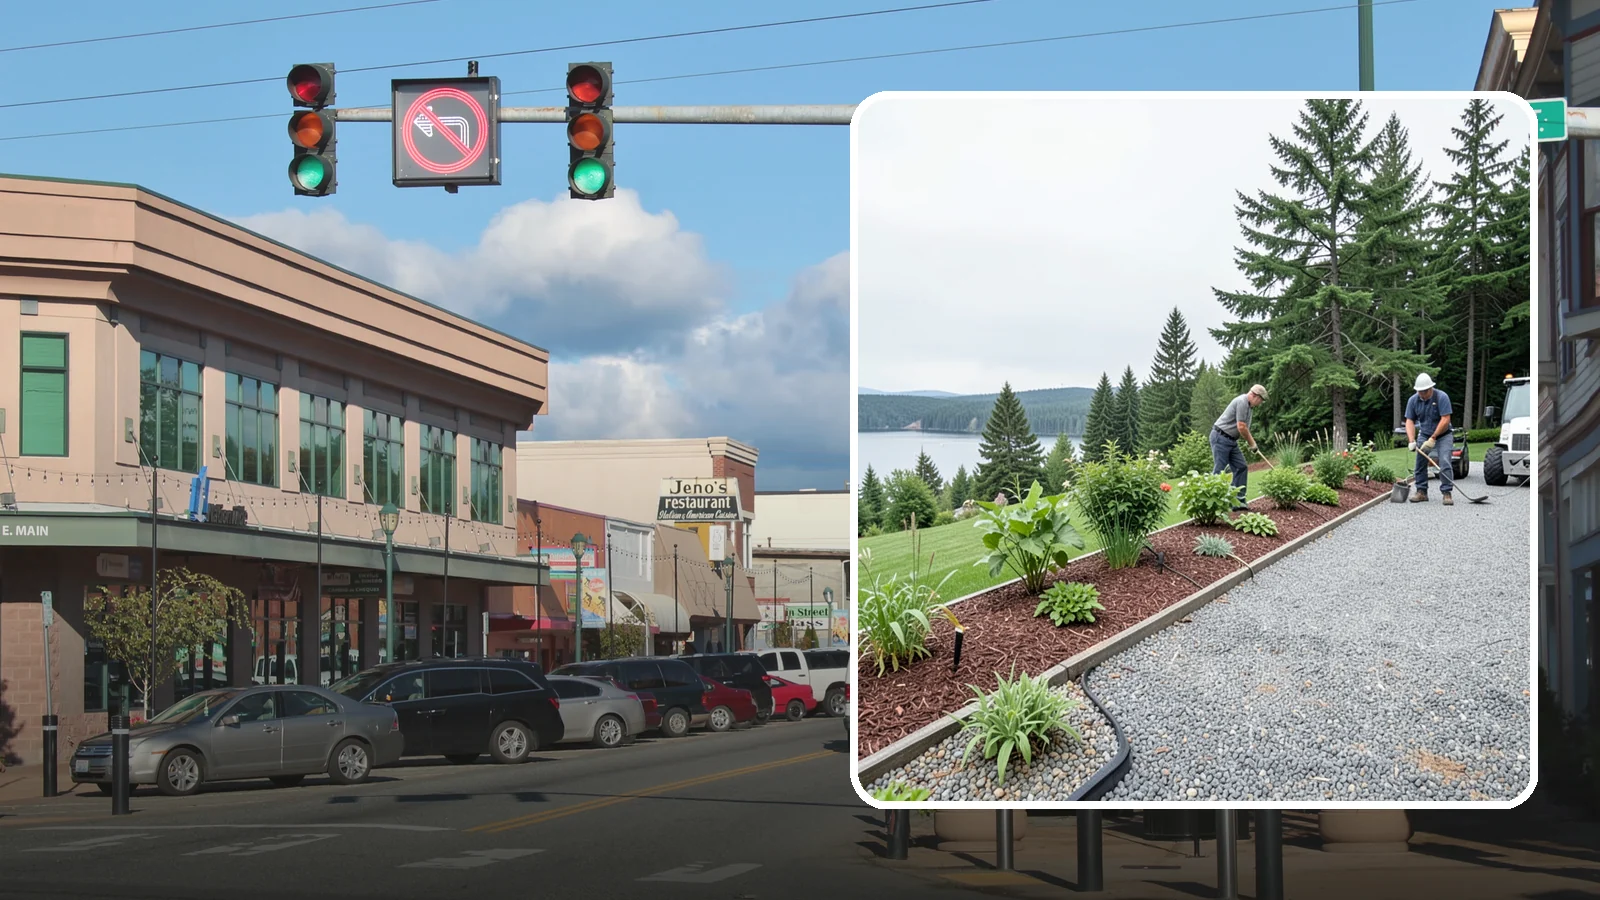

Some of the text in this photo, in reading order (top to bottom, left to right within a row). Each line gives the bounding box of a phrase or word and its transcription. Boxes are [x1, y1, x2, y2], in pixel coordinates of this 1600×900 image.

[669, 480, 727, 494] Jeno's
[665, 496, 731, 509] restaurant
[658, 510, 680, 519] Italian
[686, 510, 714, 519] American
[715, 509, 737, 519] Cuisine
[2, 525, 49, 536] E. MAIN
[797, 607, 828, 616] Street
